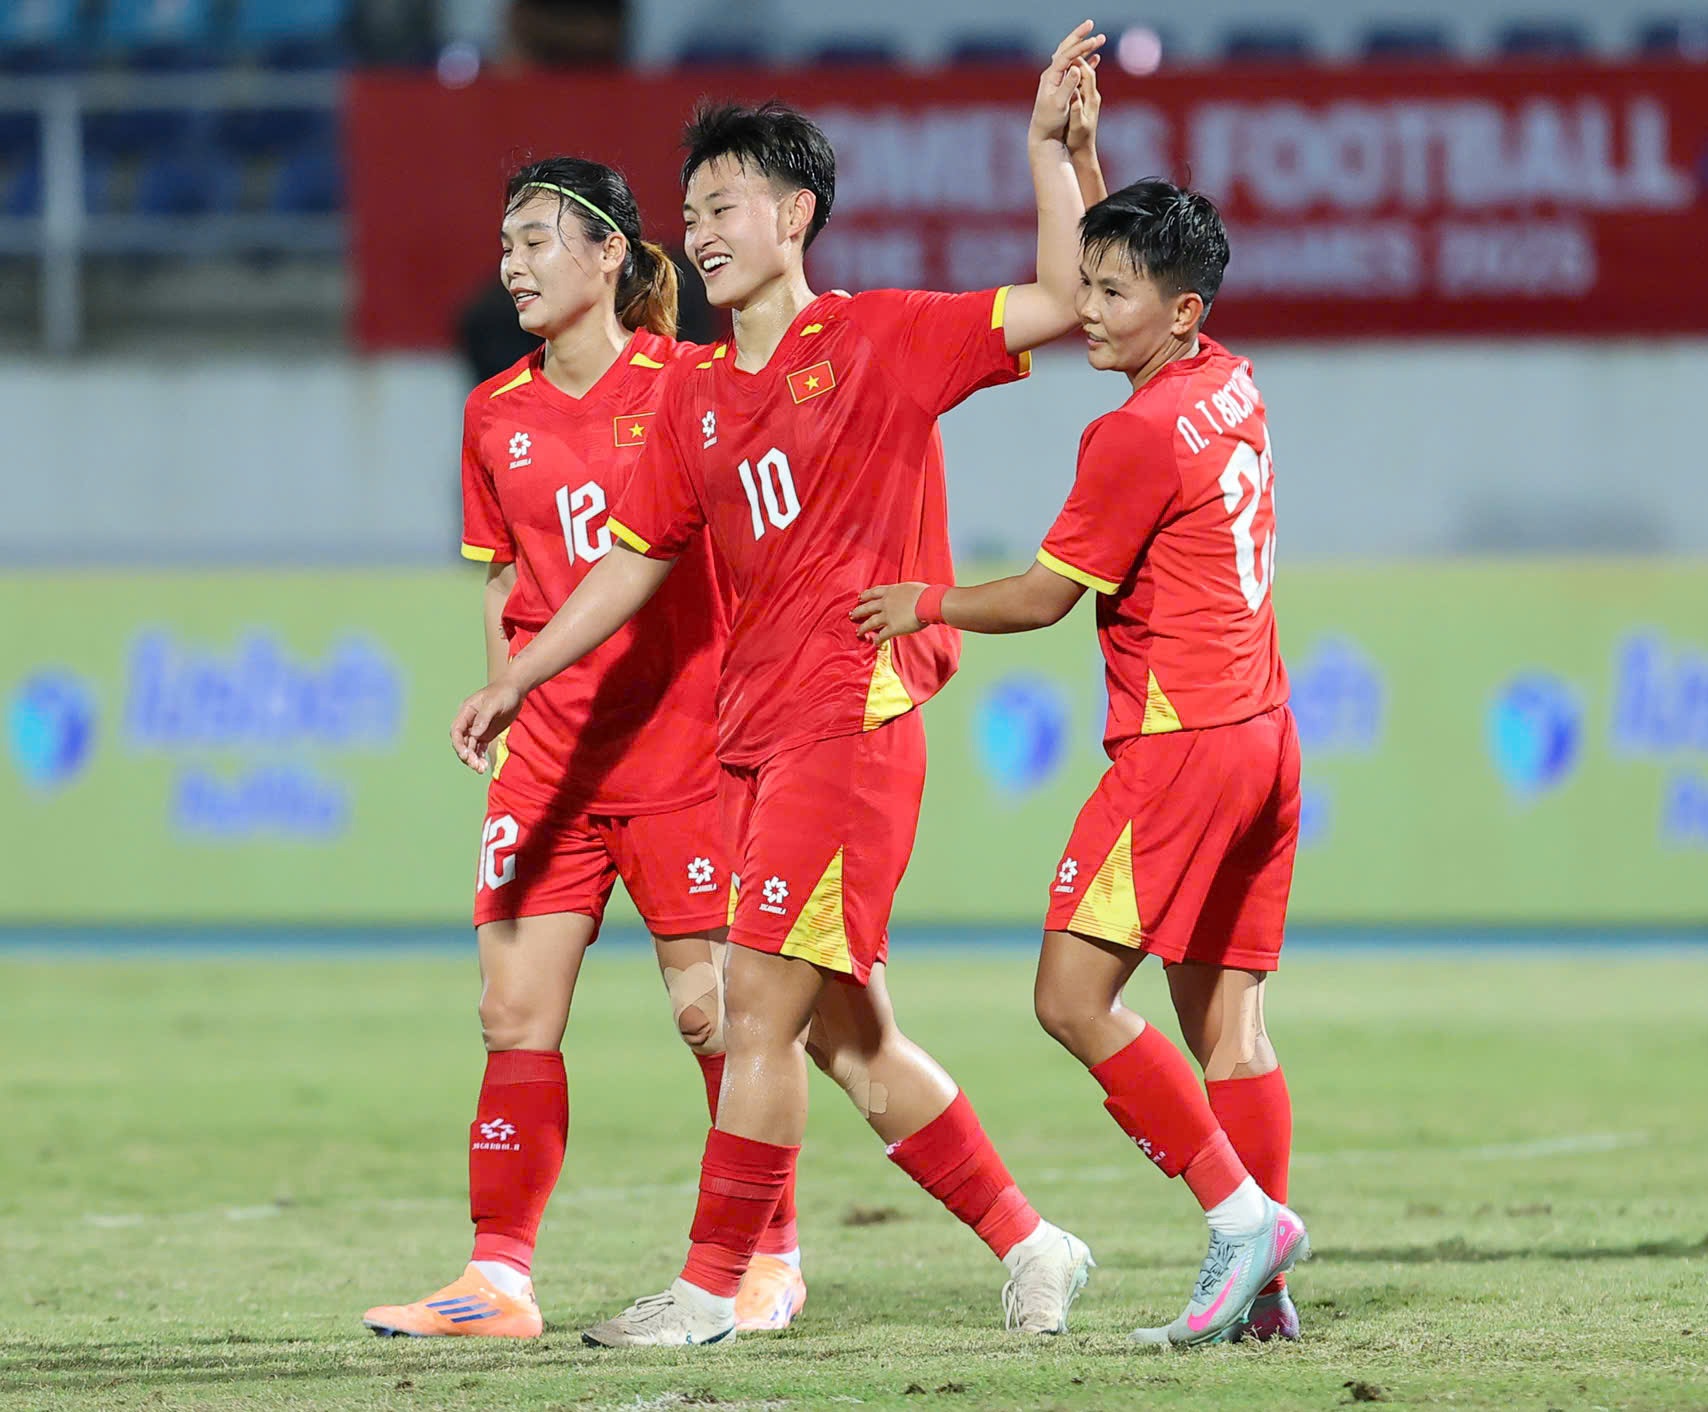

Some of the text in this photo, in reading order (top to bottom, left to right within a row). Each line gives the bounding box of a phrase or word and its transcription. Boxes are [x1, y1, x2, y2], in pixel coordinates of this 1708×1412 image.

[1192, 98, 1692, 212] FOOTBALL
[555, 480, 612, 567] 12
[737, 447, 801, 542] 10
[477, 814, 520, 893] 12
